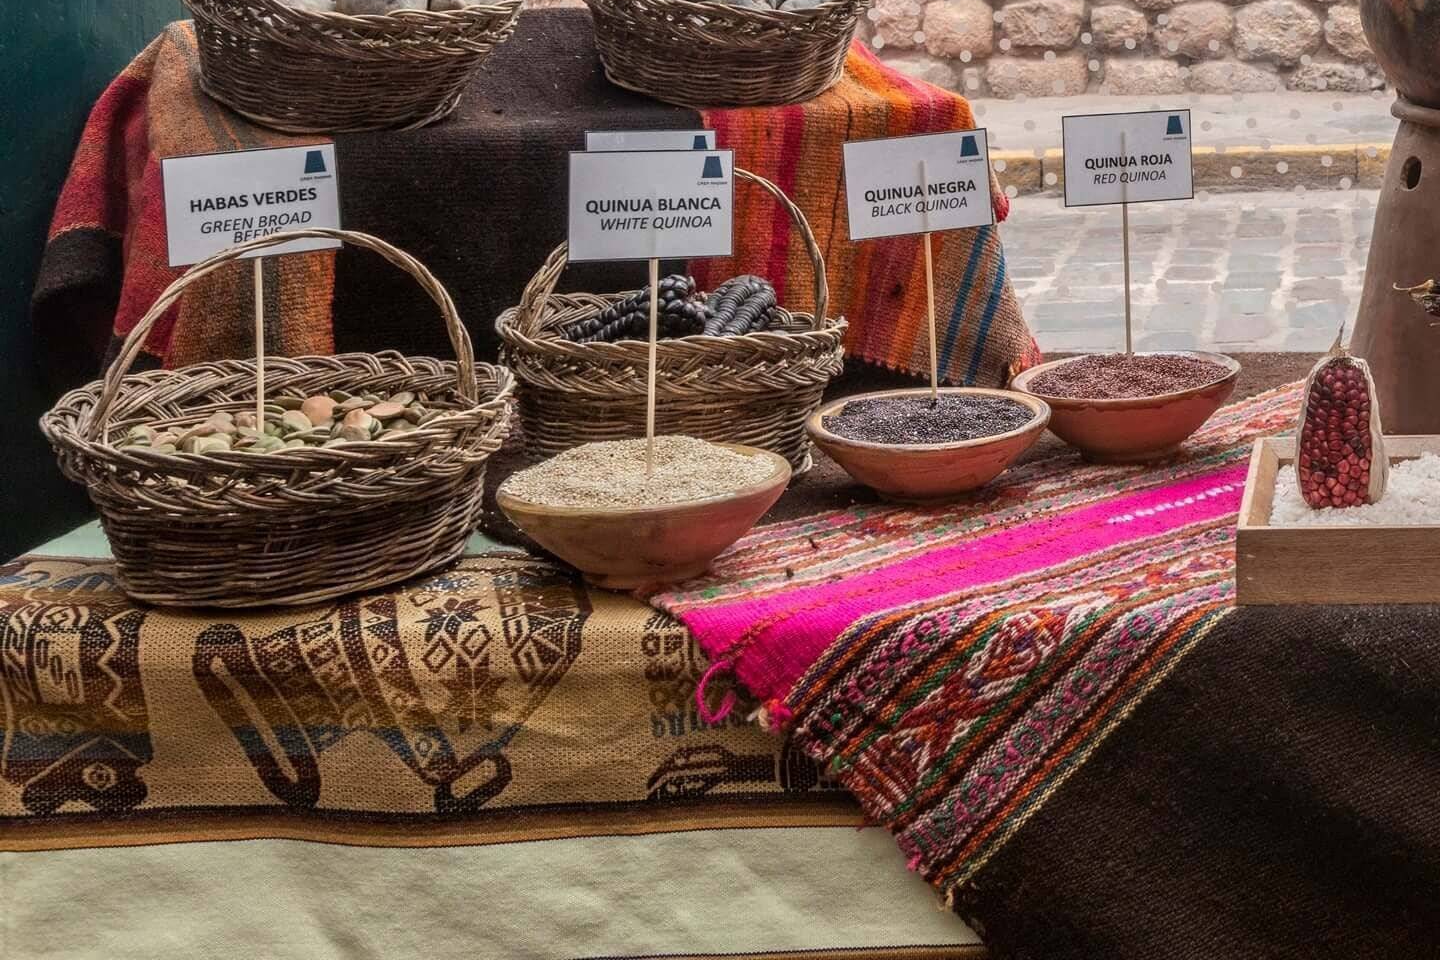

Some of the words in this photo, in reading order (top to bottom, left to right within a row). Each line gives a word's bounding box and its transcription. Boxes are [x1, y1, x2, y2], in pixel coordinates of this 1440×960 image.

[1085, 156, 1137, 170] QUINUA
[1141, 154, 1172, 165] ROJA
[1094, 174, 1116, 184] RED
[1120, 170, 1166, 183] QUINOA
[865, 185, 924, 202] QUINUA
[928, 180, 976, 195] NEGRA
[190, 195, 248, 213] HABAS
[253, 188, 317, 205] VERDES
[586, 199, 653, 214] QUINUA
[658, 198, 721, 211] BLANCA
[872, 202, 912, 217] BLACK
[916, 197, 967, 213] QUINOA
[201, 217, 253, 233] GREEN
[258, 211, 311, 228] BROAD
[601, 217, 648, 230] WHITE
[653, 216, 712, 230] QUINOA
